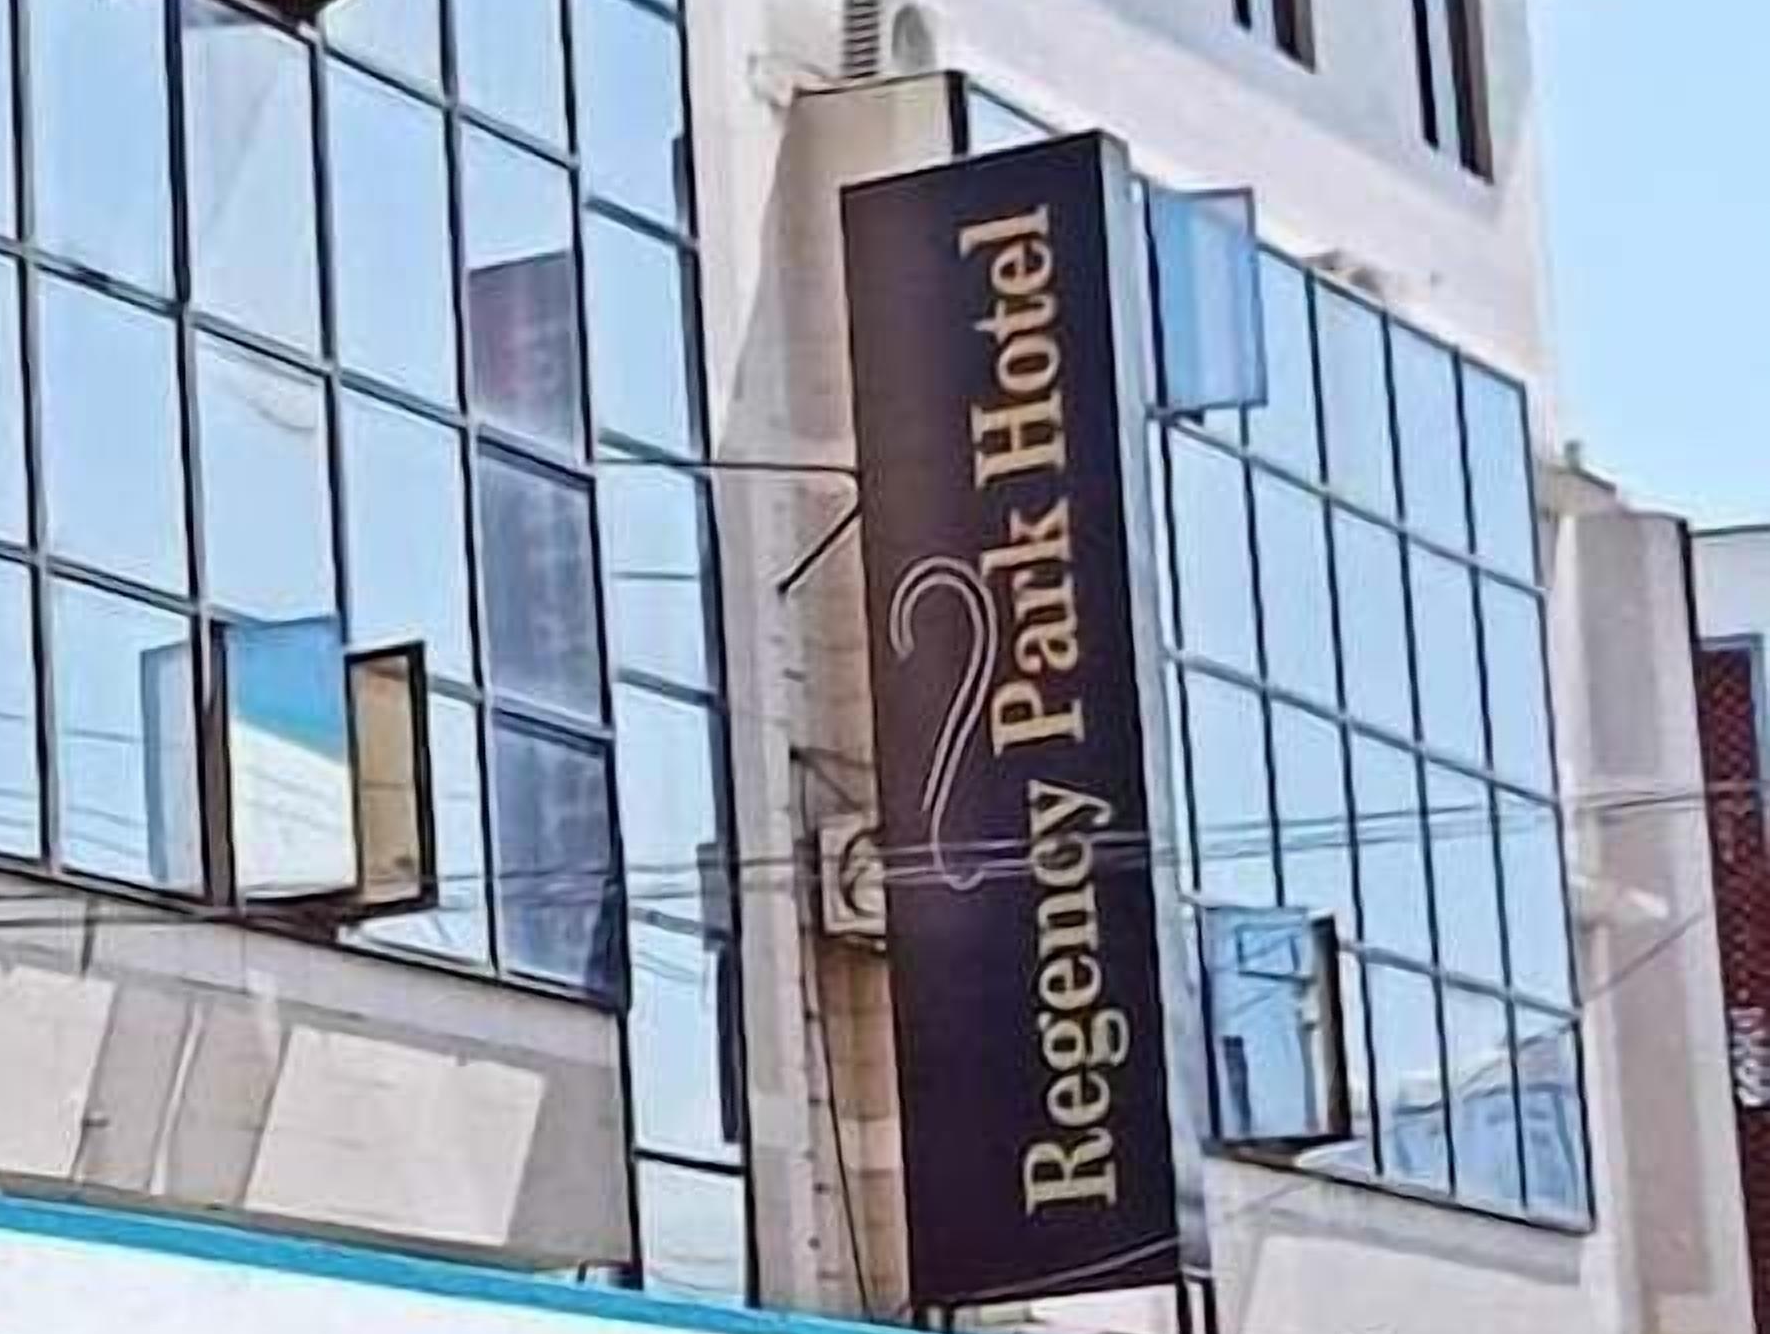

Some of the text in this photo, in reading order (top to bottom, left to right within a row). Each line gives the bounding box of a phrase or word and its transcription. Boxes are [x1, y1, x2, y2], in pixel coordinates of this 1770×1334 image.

[957, 203, 1130, 1217] Regency Park Hotel
